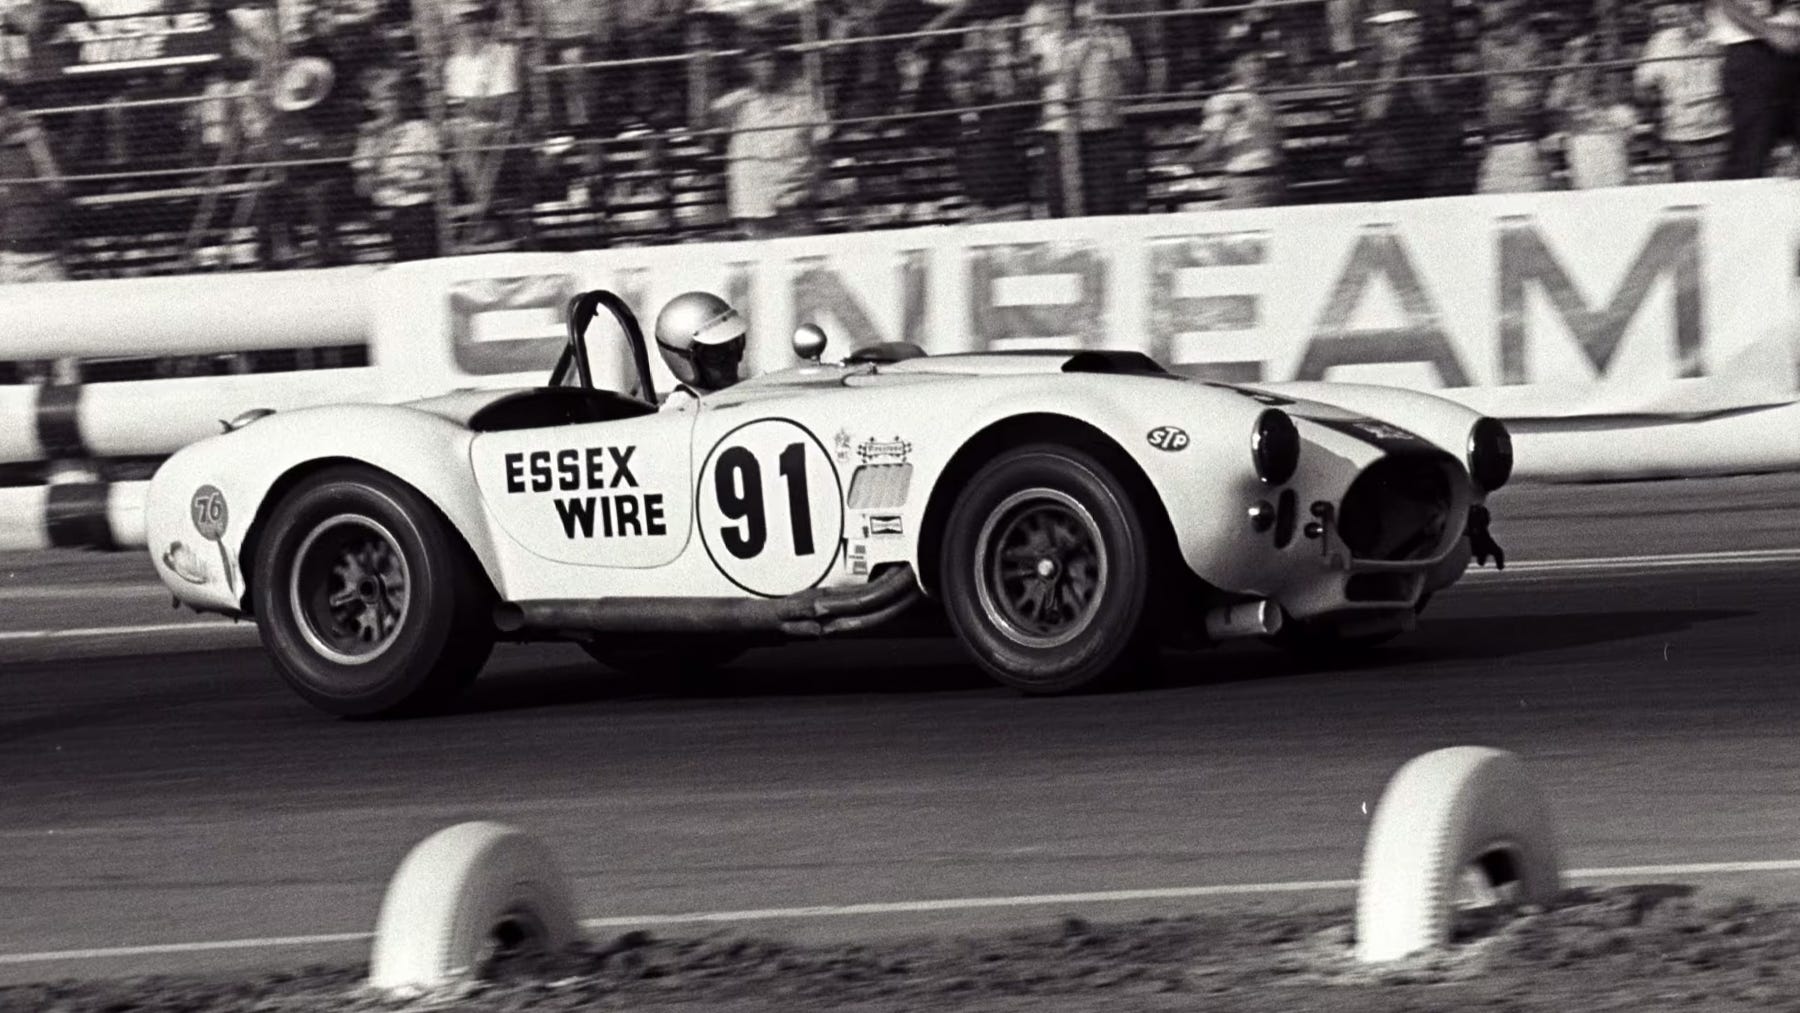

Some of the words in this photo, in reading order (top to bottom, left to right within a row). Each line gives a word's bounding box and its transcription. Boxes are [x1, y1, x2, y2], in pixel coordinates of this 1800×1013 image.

[1149, 427, 1187, 449] STP
[505, 446, 640, 493] ESSEX
[195, 492, 223, 525] 76
[554, 493, 667, 539] WIRE
[714, 442, 815, 559] 91
